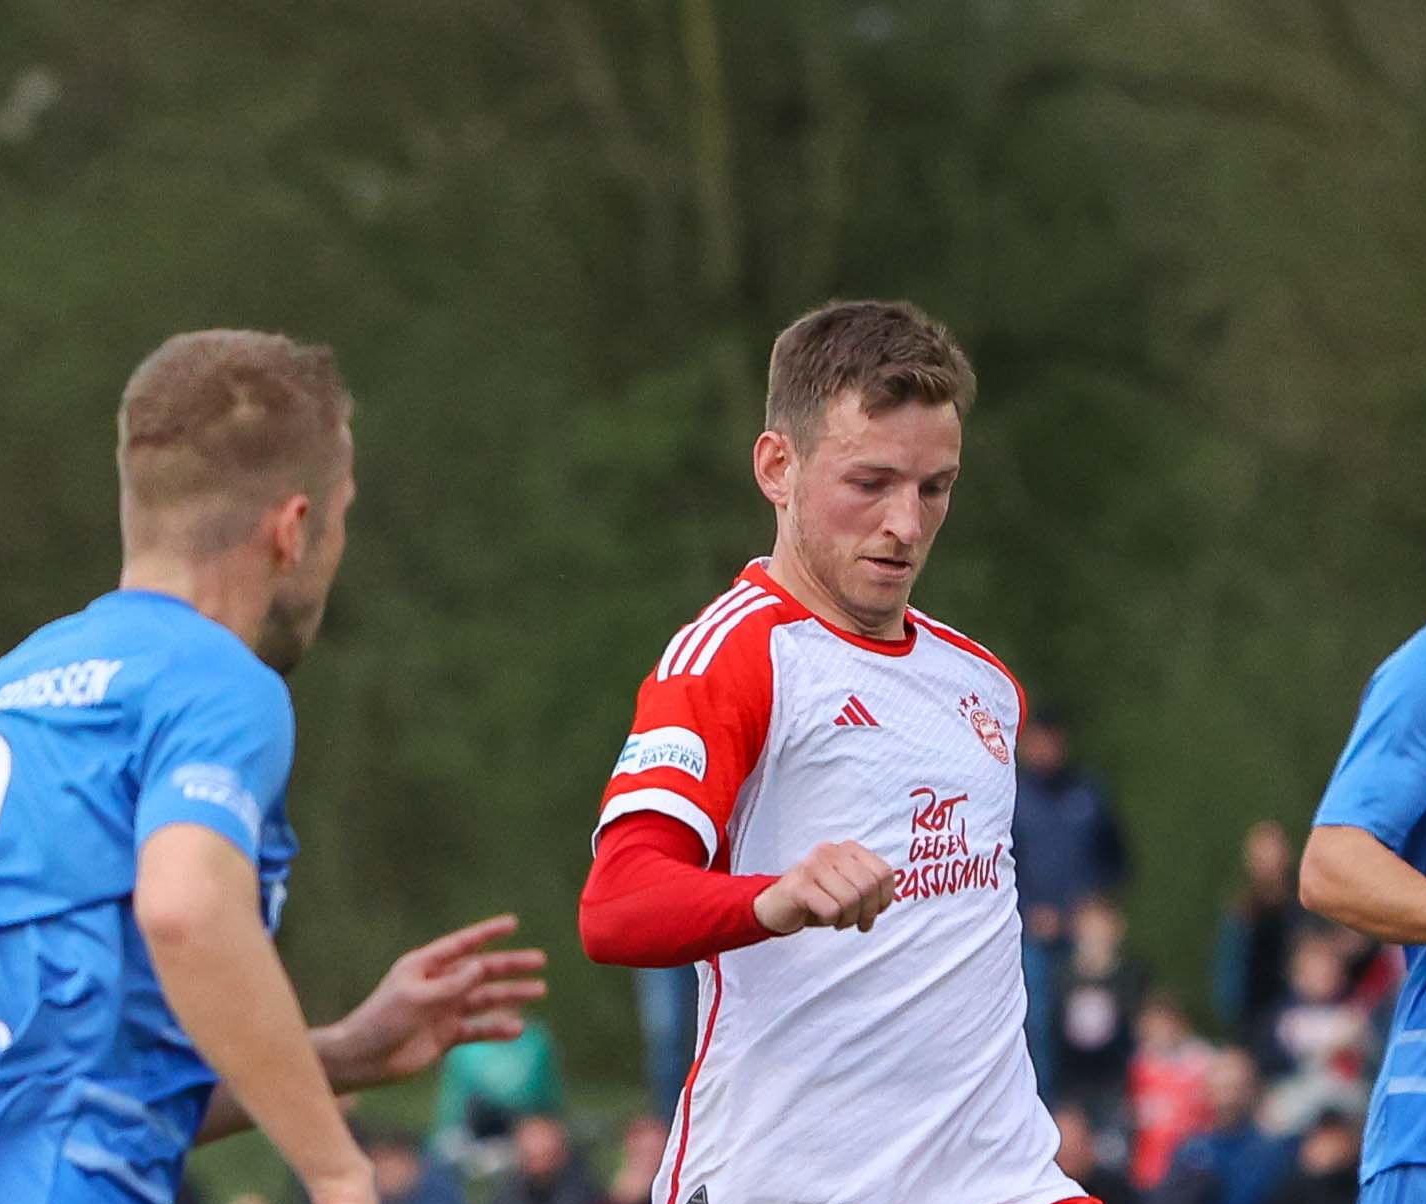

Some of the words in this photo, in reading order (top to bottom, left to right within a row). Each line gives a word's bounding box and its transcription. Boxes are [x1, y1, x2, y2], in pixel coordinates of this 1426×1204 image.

[639, 750, 702, 775] BAYERN
[909, 817, 969, 863] GEGEN
[893, 842, 1004, 902] RASSISMUS
